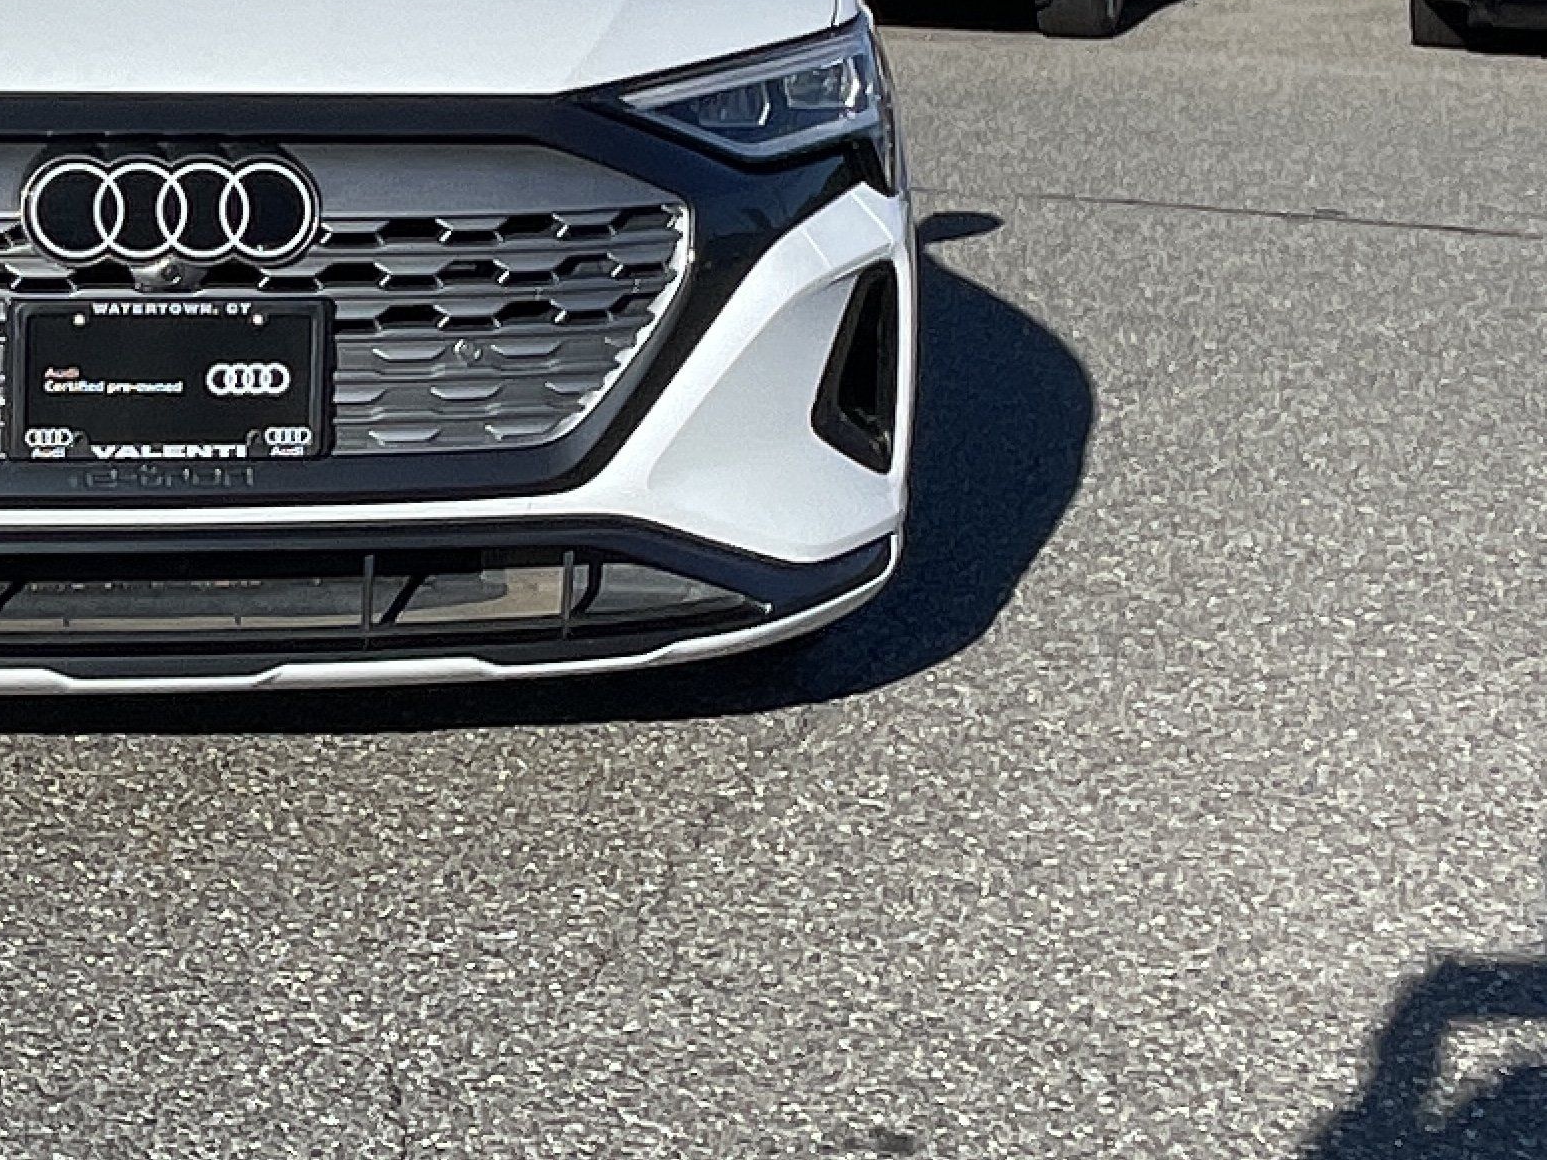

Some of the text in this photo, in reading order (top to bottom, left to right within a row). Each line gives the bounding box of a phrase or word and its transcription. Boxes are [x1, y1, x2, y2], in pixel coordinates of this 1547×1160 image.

[43, 367, 80, 378] Audi
[43, 379, 184, 394] Certified pre-owned
[90, 444, 247, 458] VALENTI
